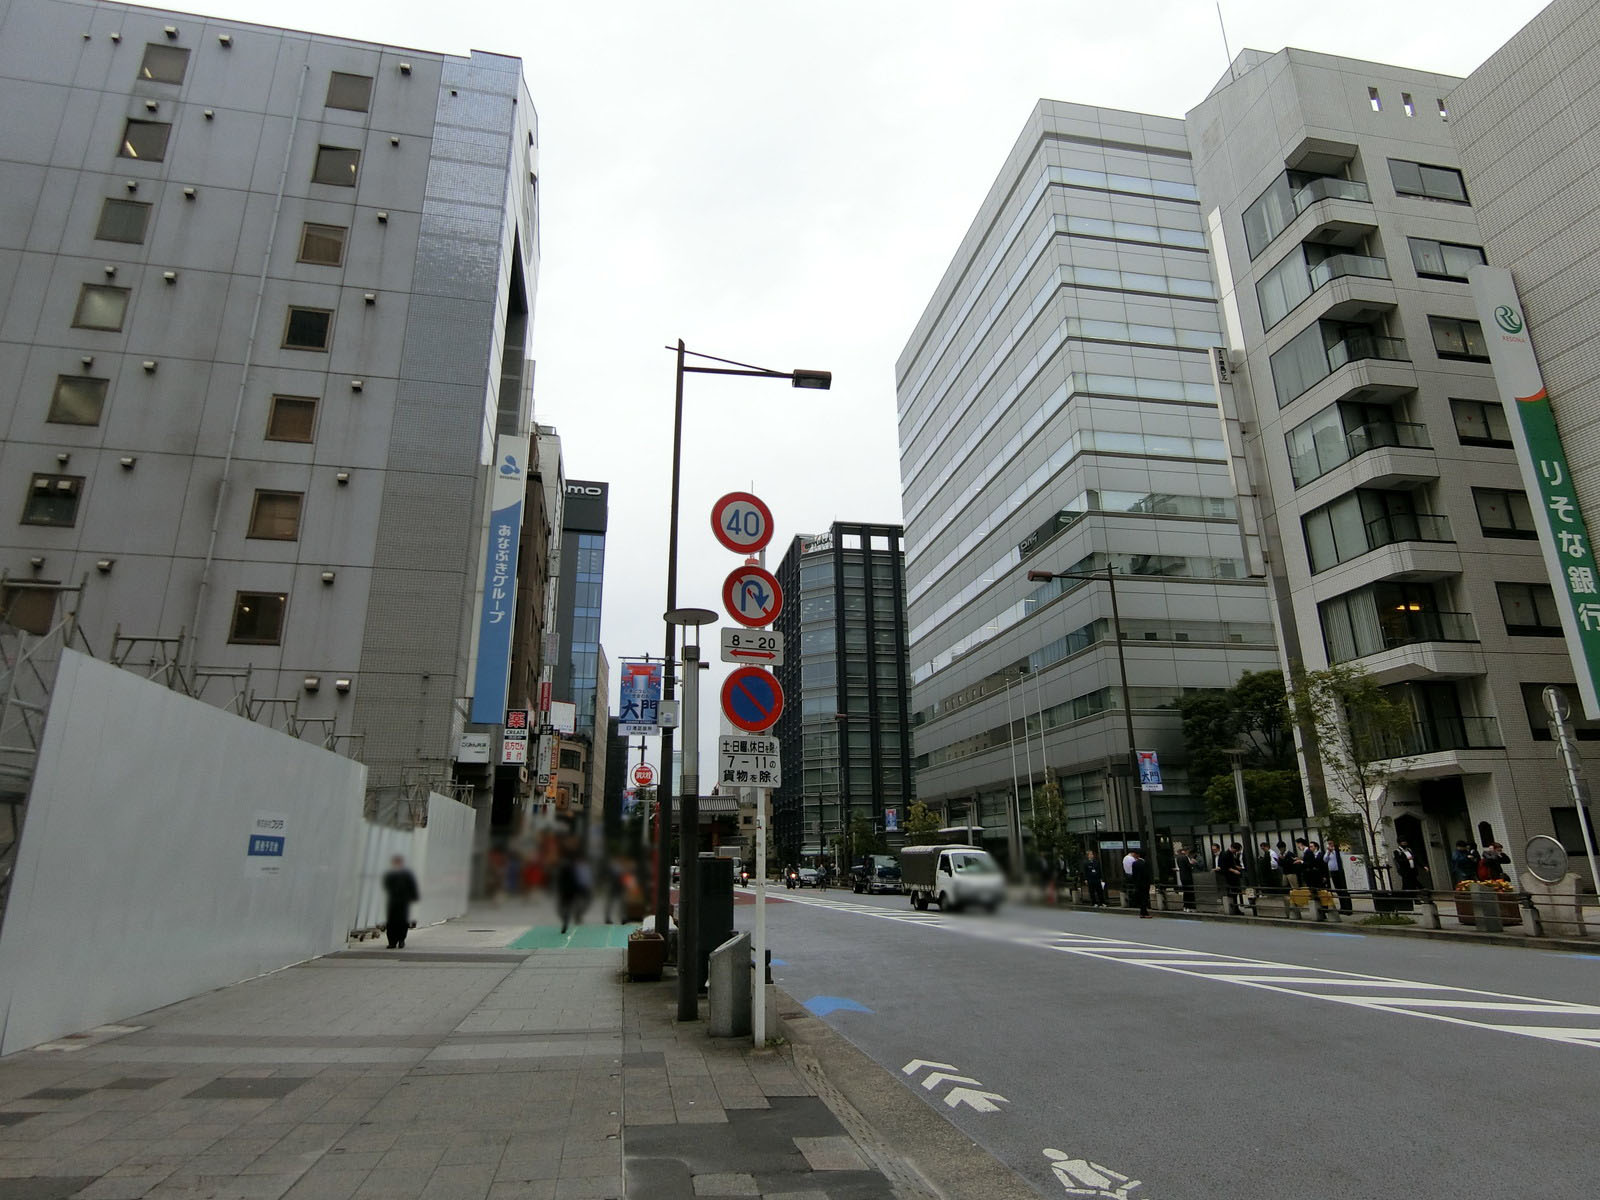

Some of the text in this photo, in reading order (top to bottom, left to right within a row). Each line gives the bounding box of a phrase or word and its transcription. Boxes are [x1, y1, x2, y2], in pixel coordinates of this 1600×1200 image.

[726, 508, 760, 537] 40
[1541, 460, 1600, 631] りそな銀行
[489, 525, 512, 623] あなぶきグループ
[507, 712, 525, 728] 薬
[620, 700, 658, 720] 大門
[723, 769, 779, 783] 貨物を除く
[1142, 771, 1160, 782] 大門
